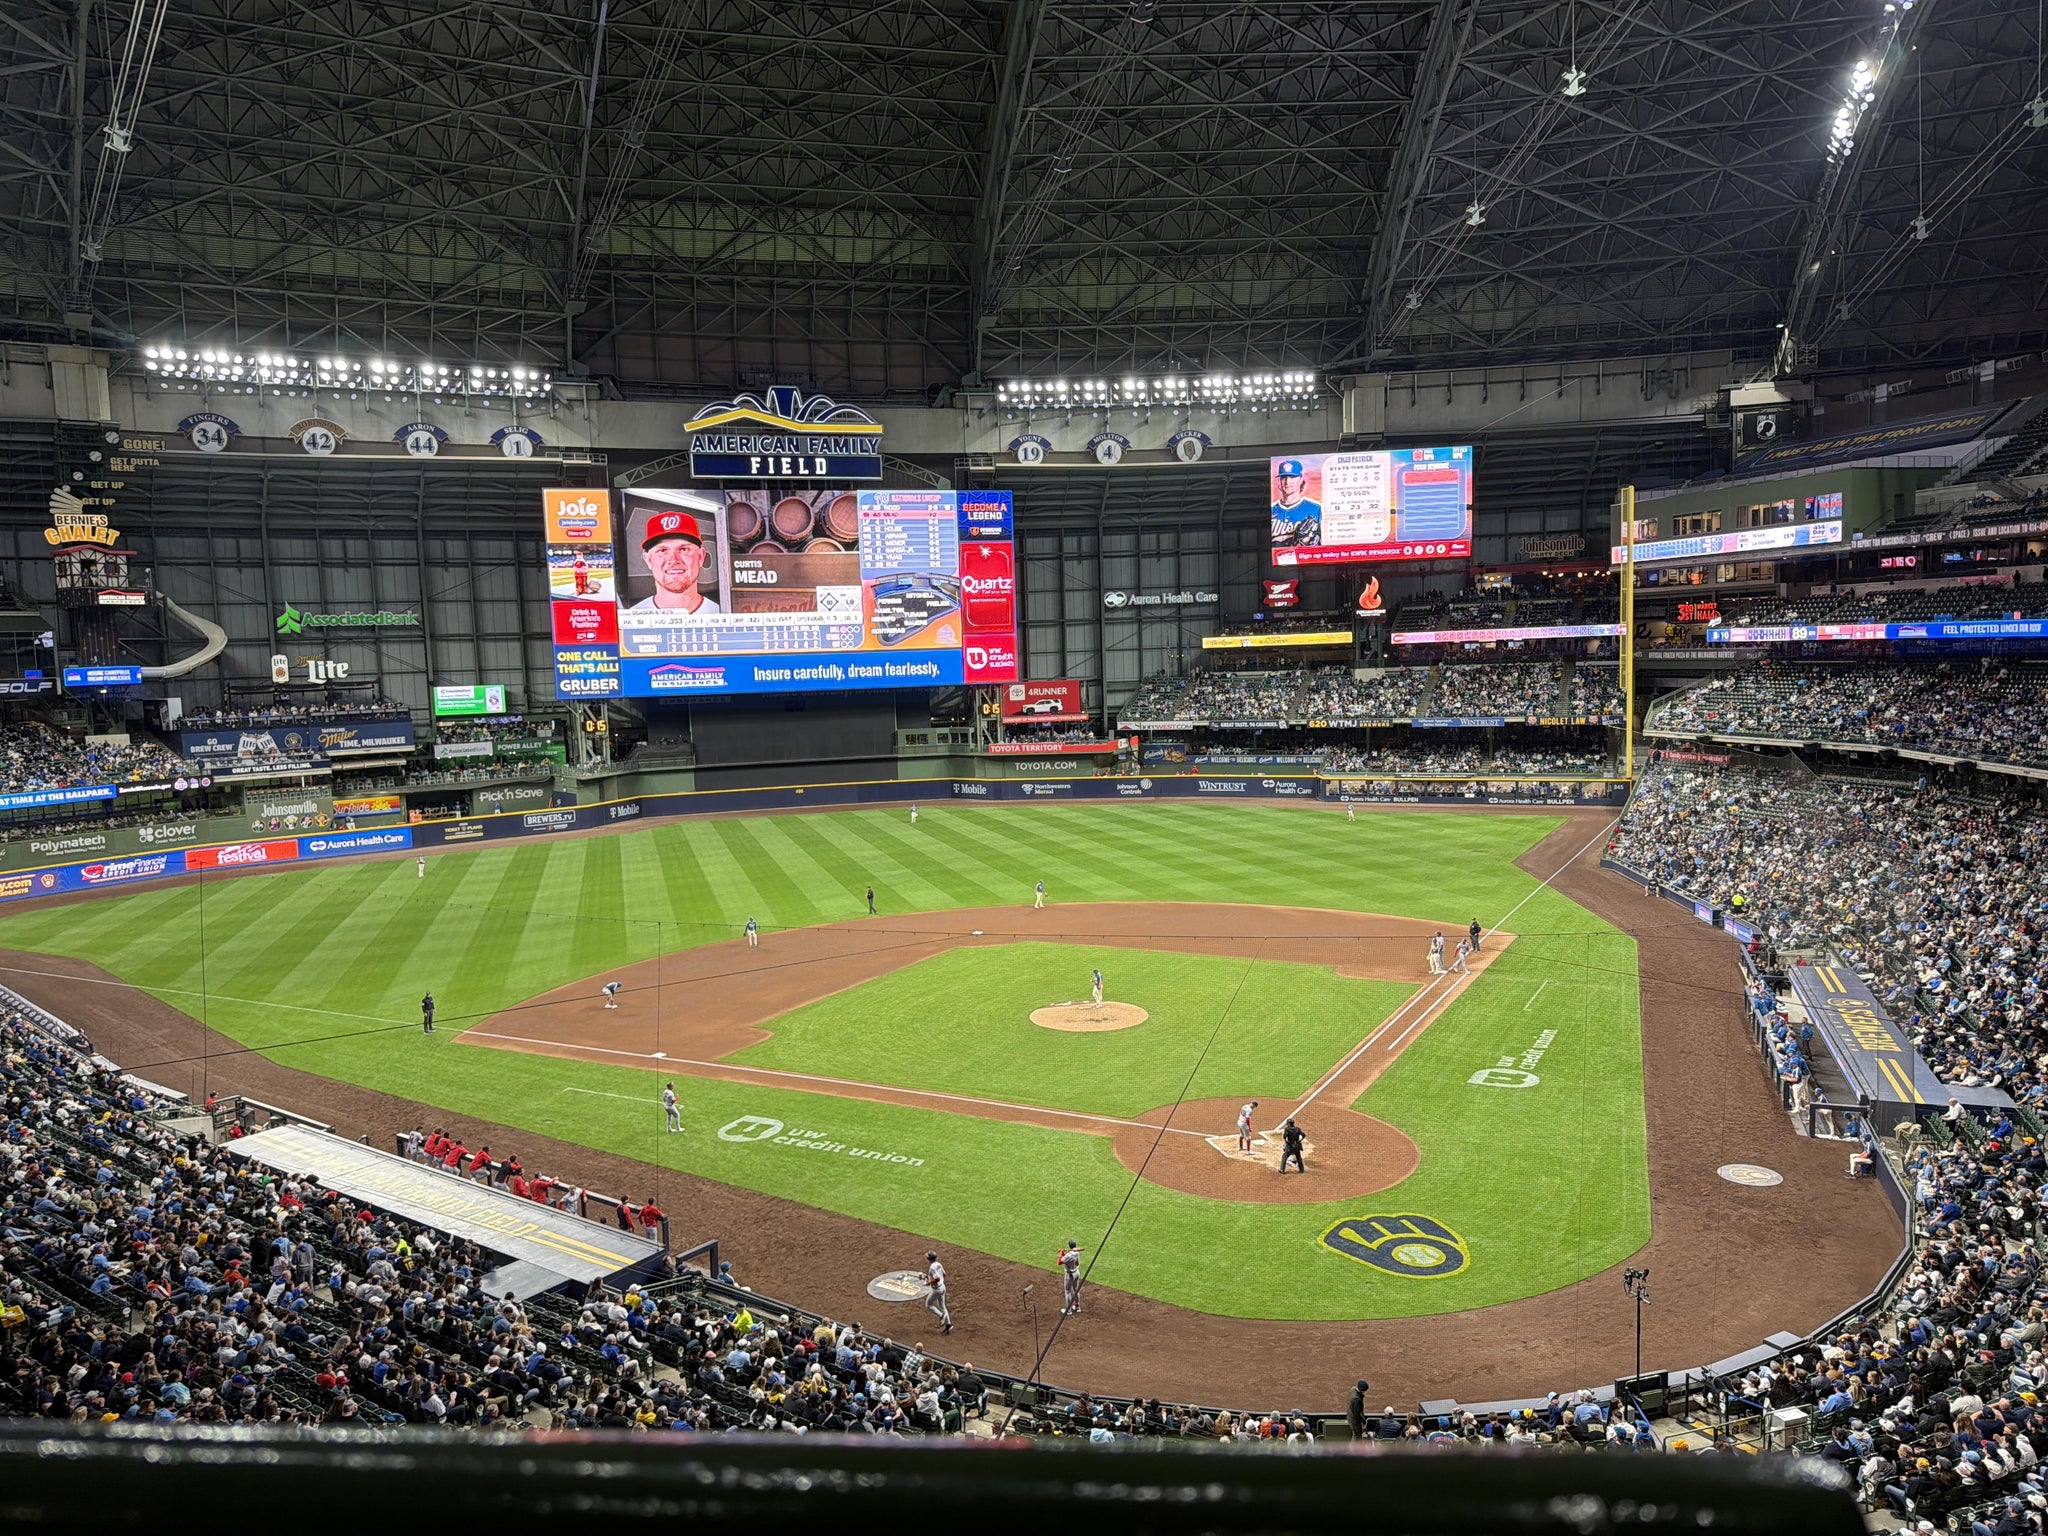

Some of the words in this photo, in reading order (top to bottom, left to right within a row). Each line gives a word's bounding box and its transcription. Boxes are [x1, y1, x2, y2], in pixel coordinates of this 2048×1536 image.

[188, 413, 230, 426] FINGERS
[407, 423, 435, 432] AARON
[503, 425, 528, 434] SELIG
[196, 428, 224, 446] 34
[306, 433, 332, 450] 42
[1018, 435, 1042, 443] YOUNT
[1093, 435, 1124, 444] MOLITOR
[1175, 431, 1201, 440] UECKER
[123, 439, 166, 451] GONE!
[410, 436, 435, 453] 44
[512, 440, 524, 456] 1
[690, 435, 800, 454] AMERICAN
[807, 436, 882, 455] FAMILY
[1022, 446, 1039, 462] 19
[1103, 445, 1112, 459] 4
[110, 457, 128, 466] GET
[130, 458, 160, 466] OUTTA
[751, 457, 826, 475] FIELD
[111, 464, 136, 472] HERE
[111, 481, 124, 489] UP
[102, 498, 116, 506] UP
[557, 497, 598, 516] Joie
[962, 503, 999, 512] BECOME
[1000, 503, 1007, 511] A
[56, 515, 107, 526] BERNIE'S
[968, 512, 1002, 520] LEGEND
[44, 526, 120, 546] CHALET
[1519, 535, 1585, 554] Johnsonville
[733, 560, 762, 568] CURTIS
[734, 570, 778, 584] MEAD
[962, 575, 1012, 594] Quartz
[1128, 593, 1161, 605] Aurora
[1162, 592, 1194, 604] Health
[1195, 592, 1218, 603] Care
[301, 611, 419, 626] AssociatedBank
[1943, 626, 1958, 634] FEEL
[1960, 625, 1999, 634] PROTECTED
[2000, 624, 2018, 633] UNDER
[557, 651, 581, 661] ONE
[989, 653, 1014, 661] credit
[307, 659, 349, 684] Lite
[557, 663, 595, 673] THAT'S
[754, 666, 791, 681] Insure
[793, 665, 845, 681] carefully,
[848, 663, 883, 677] dream
[885, 661, 940, 677] fearlessly.
[651, 673, 693, 681] AMERICAN
[695, 671, 724, 680] FAMILY
[560, 678, 619, 691] GRUBER
[1028, 687, 1068, 696] 4RUNNER
[586, 720, 607, 732] 0:15
[1309, 720, 1327, 728] 620
[1329, 719, 1357, 728] WTMJ
[1540, 717, 1568, 725] NICOLET
[1571, 717, 1586, 725] LAW
[212, 744, 234, 752] CREW
[339, 740, 361, 749] TIME,
[362, 736, 406, 747] MILWAUKEE
[497, 743, 520, 751] POWER
[1021, 744, 1063, 752] TERRITORY
[252, 765, 272, 773] TASTE.
[1015, 761, 1077, 770] TOYOTA.COM
[1198, 781, 1247, 790] WINTRUST
[11, 796, 34, 805] TIME
[66, 788, 113, 798] BALLPARK.
[516, 787, 544, 798] Save
[261, 800, 318, 818] Johnsonville
[155, 824, 196, 838] clover
[31, 835, 106, 853] Polymatech
[327, 837, 355, 850] Aurora
[357, 835, 384, 846] Health
[384, 834, 404, 843] Care
[216, 846, 268, 865] festival
[102, 868, 134, 879] CREDIT
[137, 863, 166, 875] UNION
[1837, 1008, 1903, 1053] BREWERS
[788, 1128, 828, 1140] uw
[773, 1135, 847, 1153] credit
[848, 1146, 925, 1168] union
